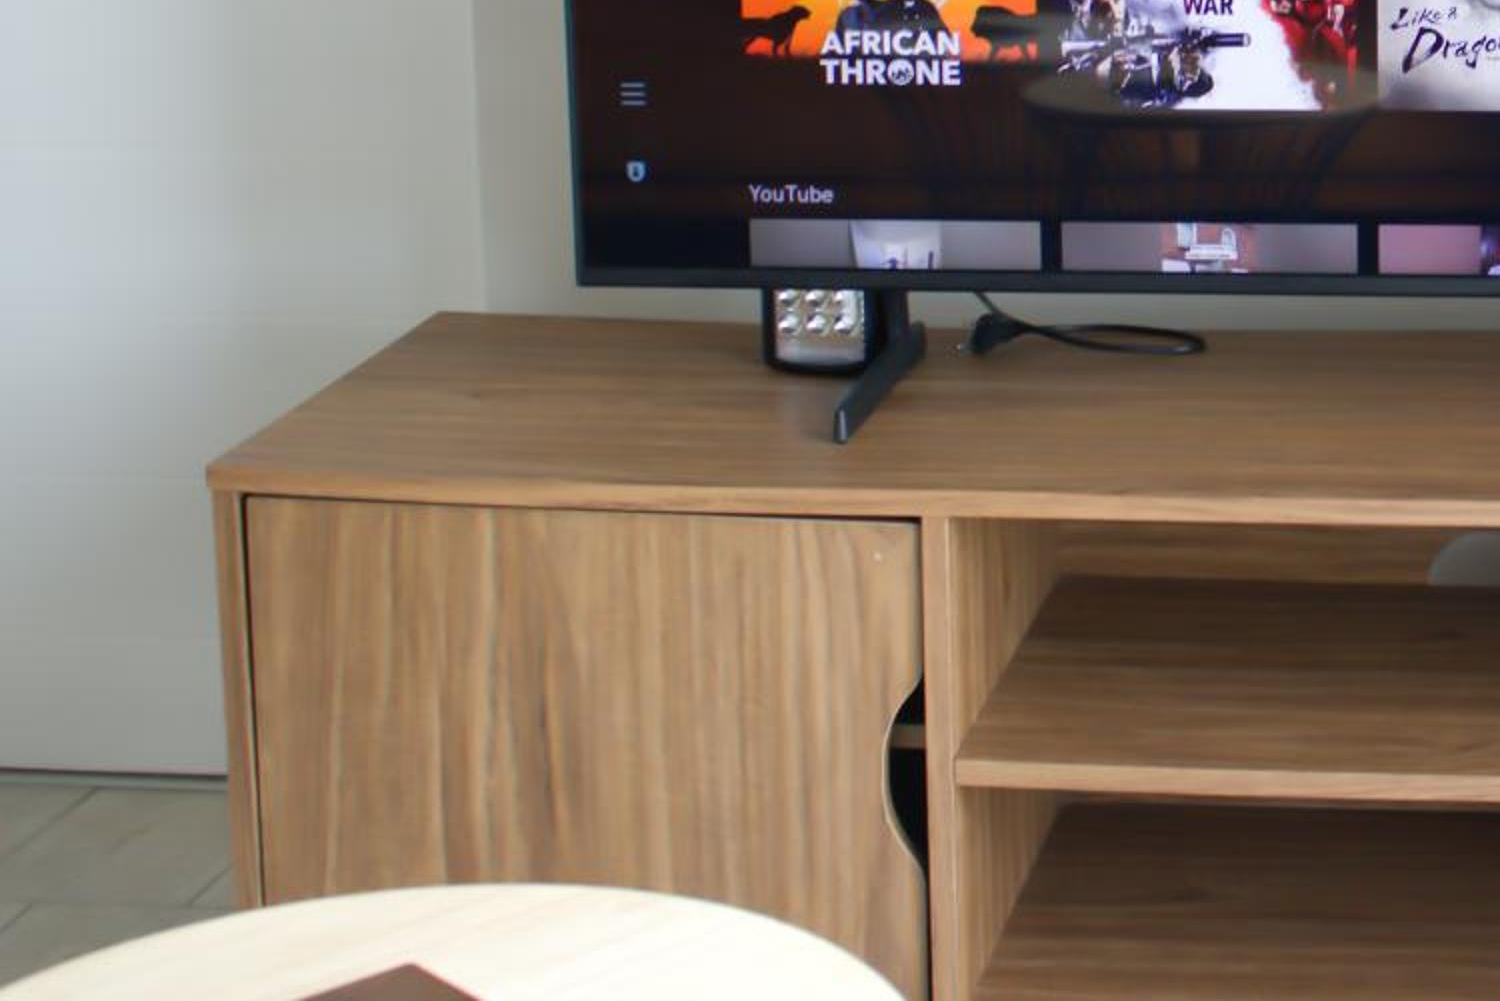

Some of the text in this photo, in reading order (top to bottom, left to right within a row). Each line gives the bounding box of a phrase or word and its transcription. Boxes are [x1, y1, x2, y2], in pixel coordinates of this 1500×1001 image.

[821, 30, 960, 55] AFRICAN
[819, 59, 961, 85] THRONE
[748, 184, 834, 203] YouTube
